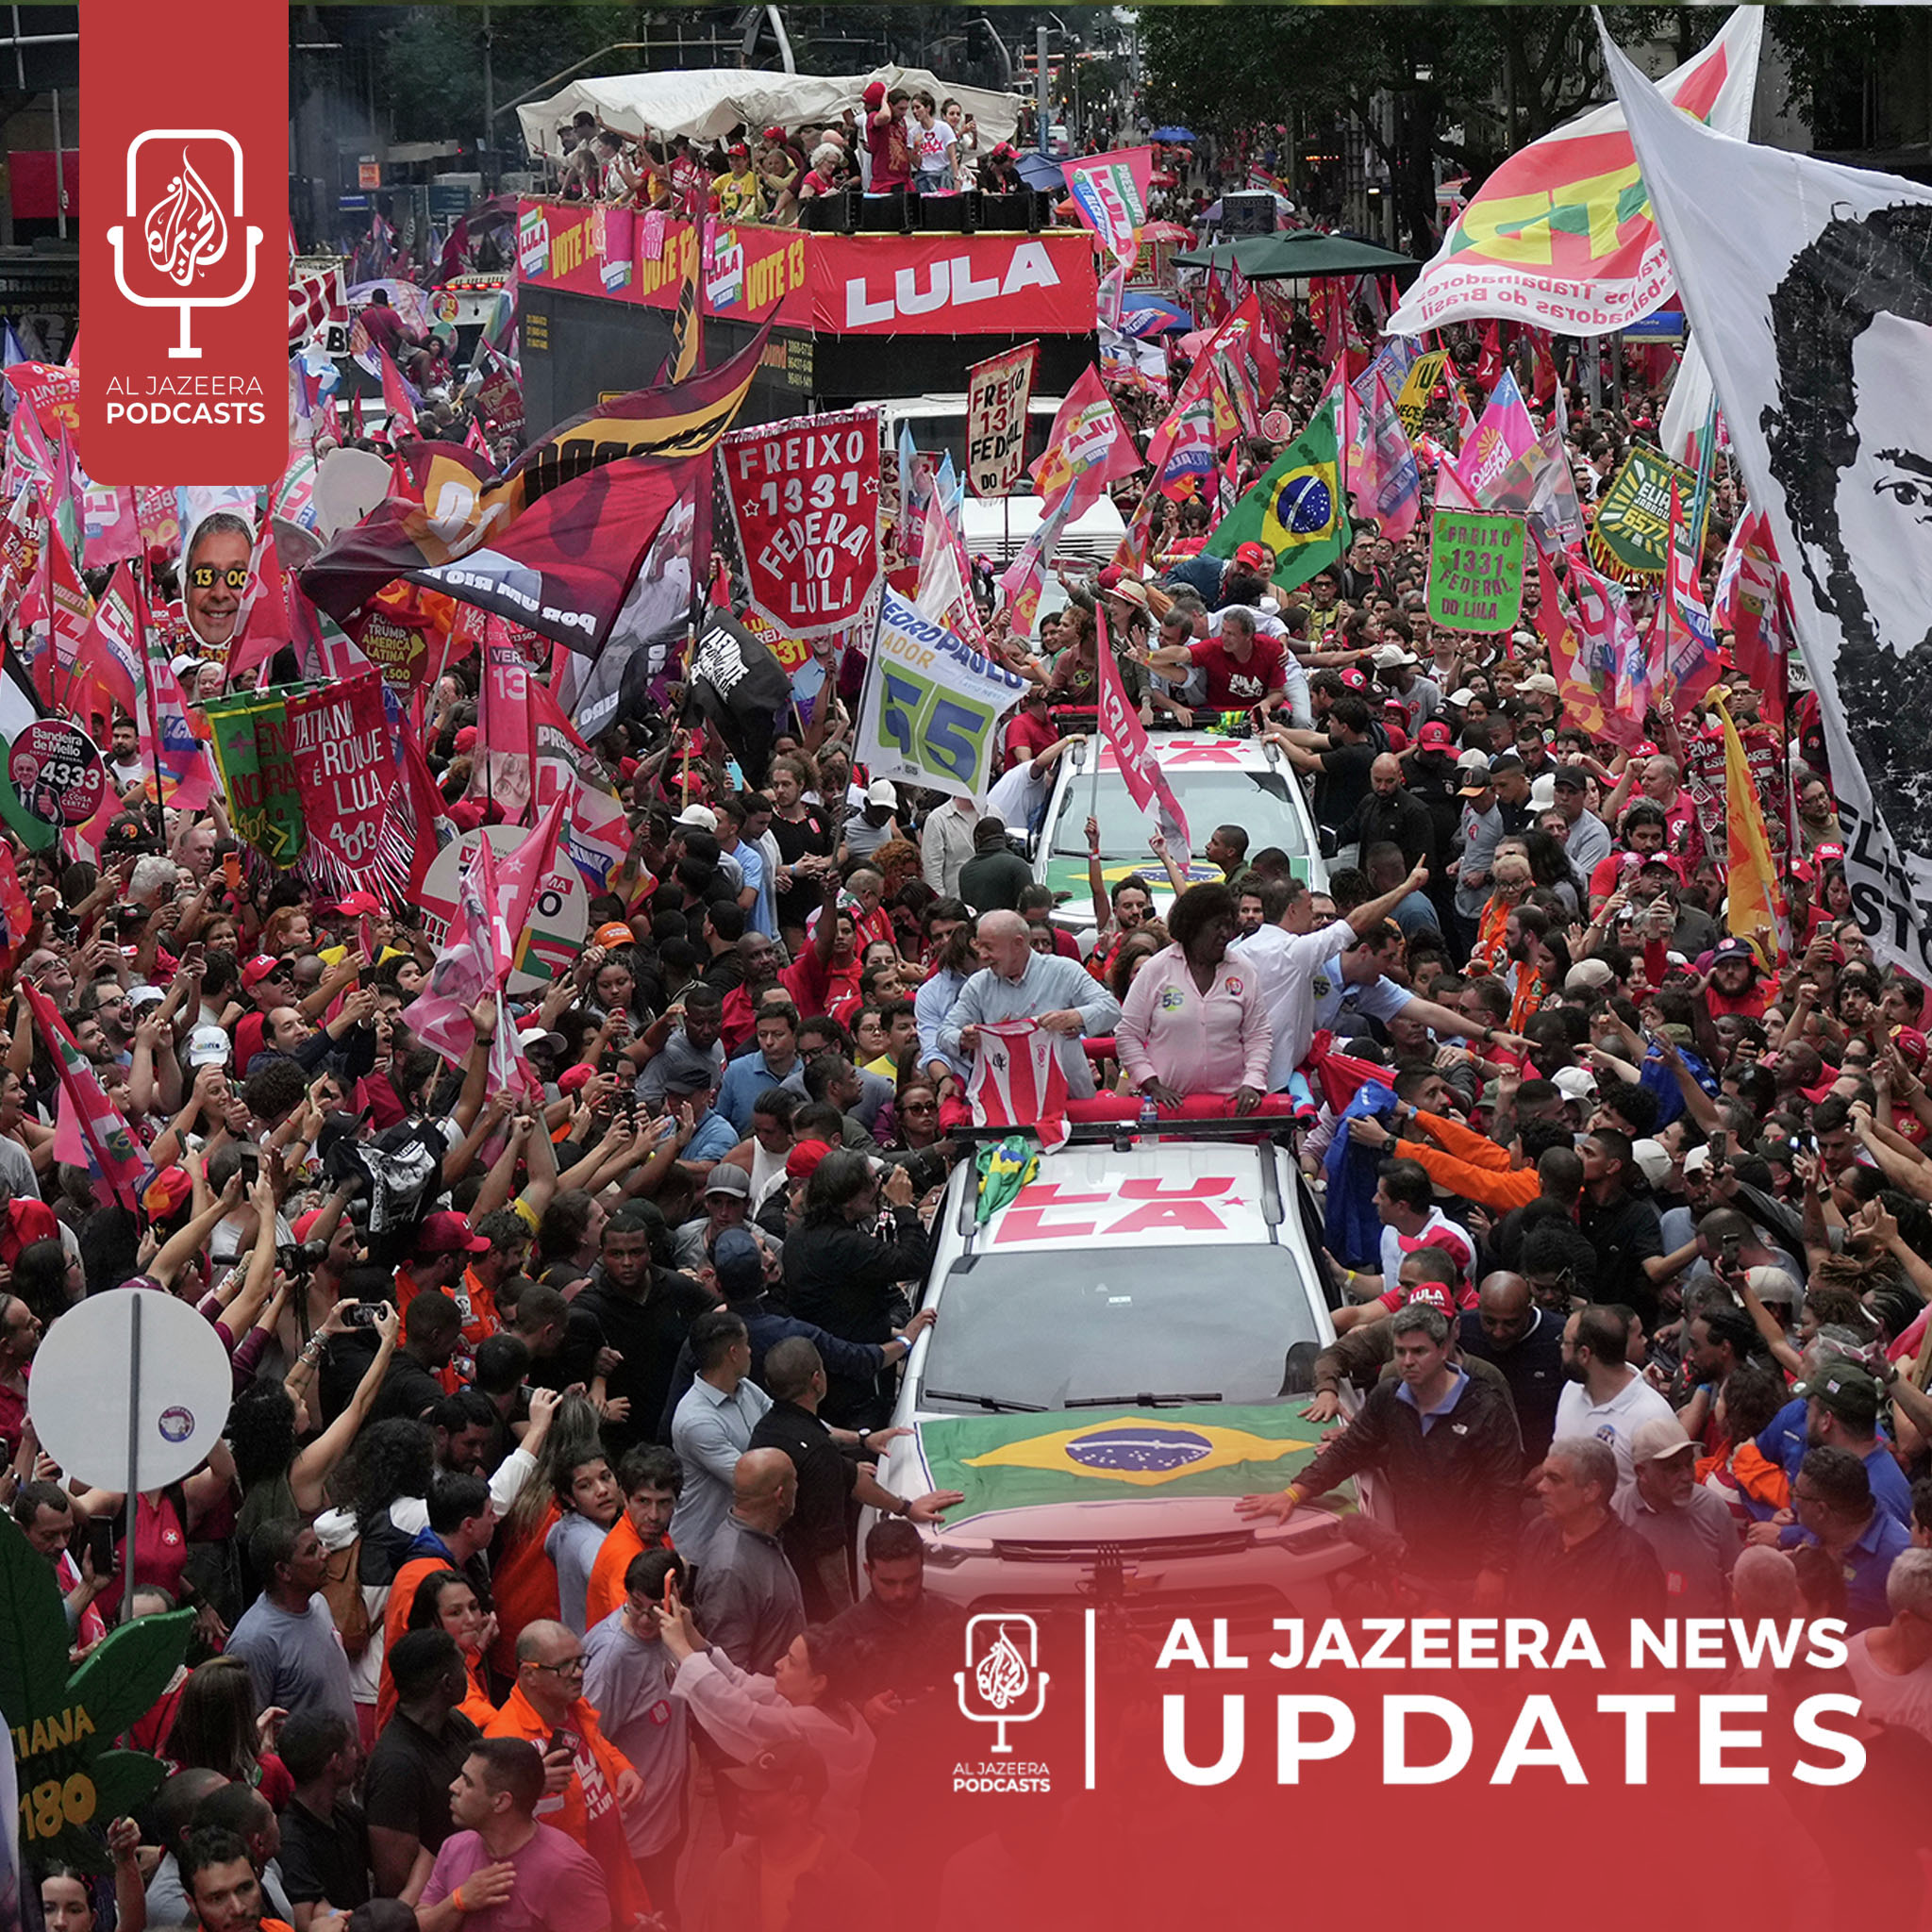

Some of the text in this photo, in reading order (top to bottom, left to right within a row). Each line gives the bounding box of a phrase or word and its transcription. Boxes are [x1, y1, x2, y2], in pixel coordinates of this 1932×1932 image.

[552, 224, 582, 279] VOTE
[746, 249, 785, 311] VOTE
[789, 239, 805, 291] 13
[846, 242, 1061, 328] LULA
[739, 430, 865, 479] FREIXO
[760, 472, 858, 516] 1331
[981, 473, 997, 490] DO
[1448, 526, 1511, 547] FREIXO
[804, 547, 834, 579] DO
[1452, 549, 1504, 576] 1331
[195, 569, 211, 585] 13
[1440, 569, 1513, 597] FEDERAL
[791, 576, 853, 613] LULA
[1441, 598, 1458, 615] DO
[935, 631, 1024, 689] PAULO
[32, 726, 83, 746] Bandeira
[33, 740, 80, 757] de Mello
[40, 761, 101, 790] 4333
[330, 821, 377, 861] 4013
[1162, 992, 1184, 1008] 55
[1410, 1289, 1444, 1304] LULA
